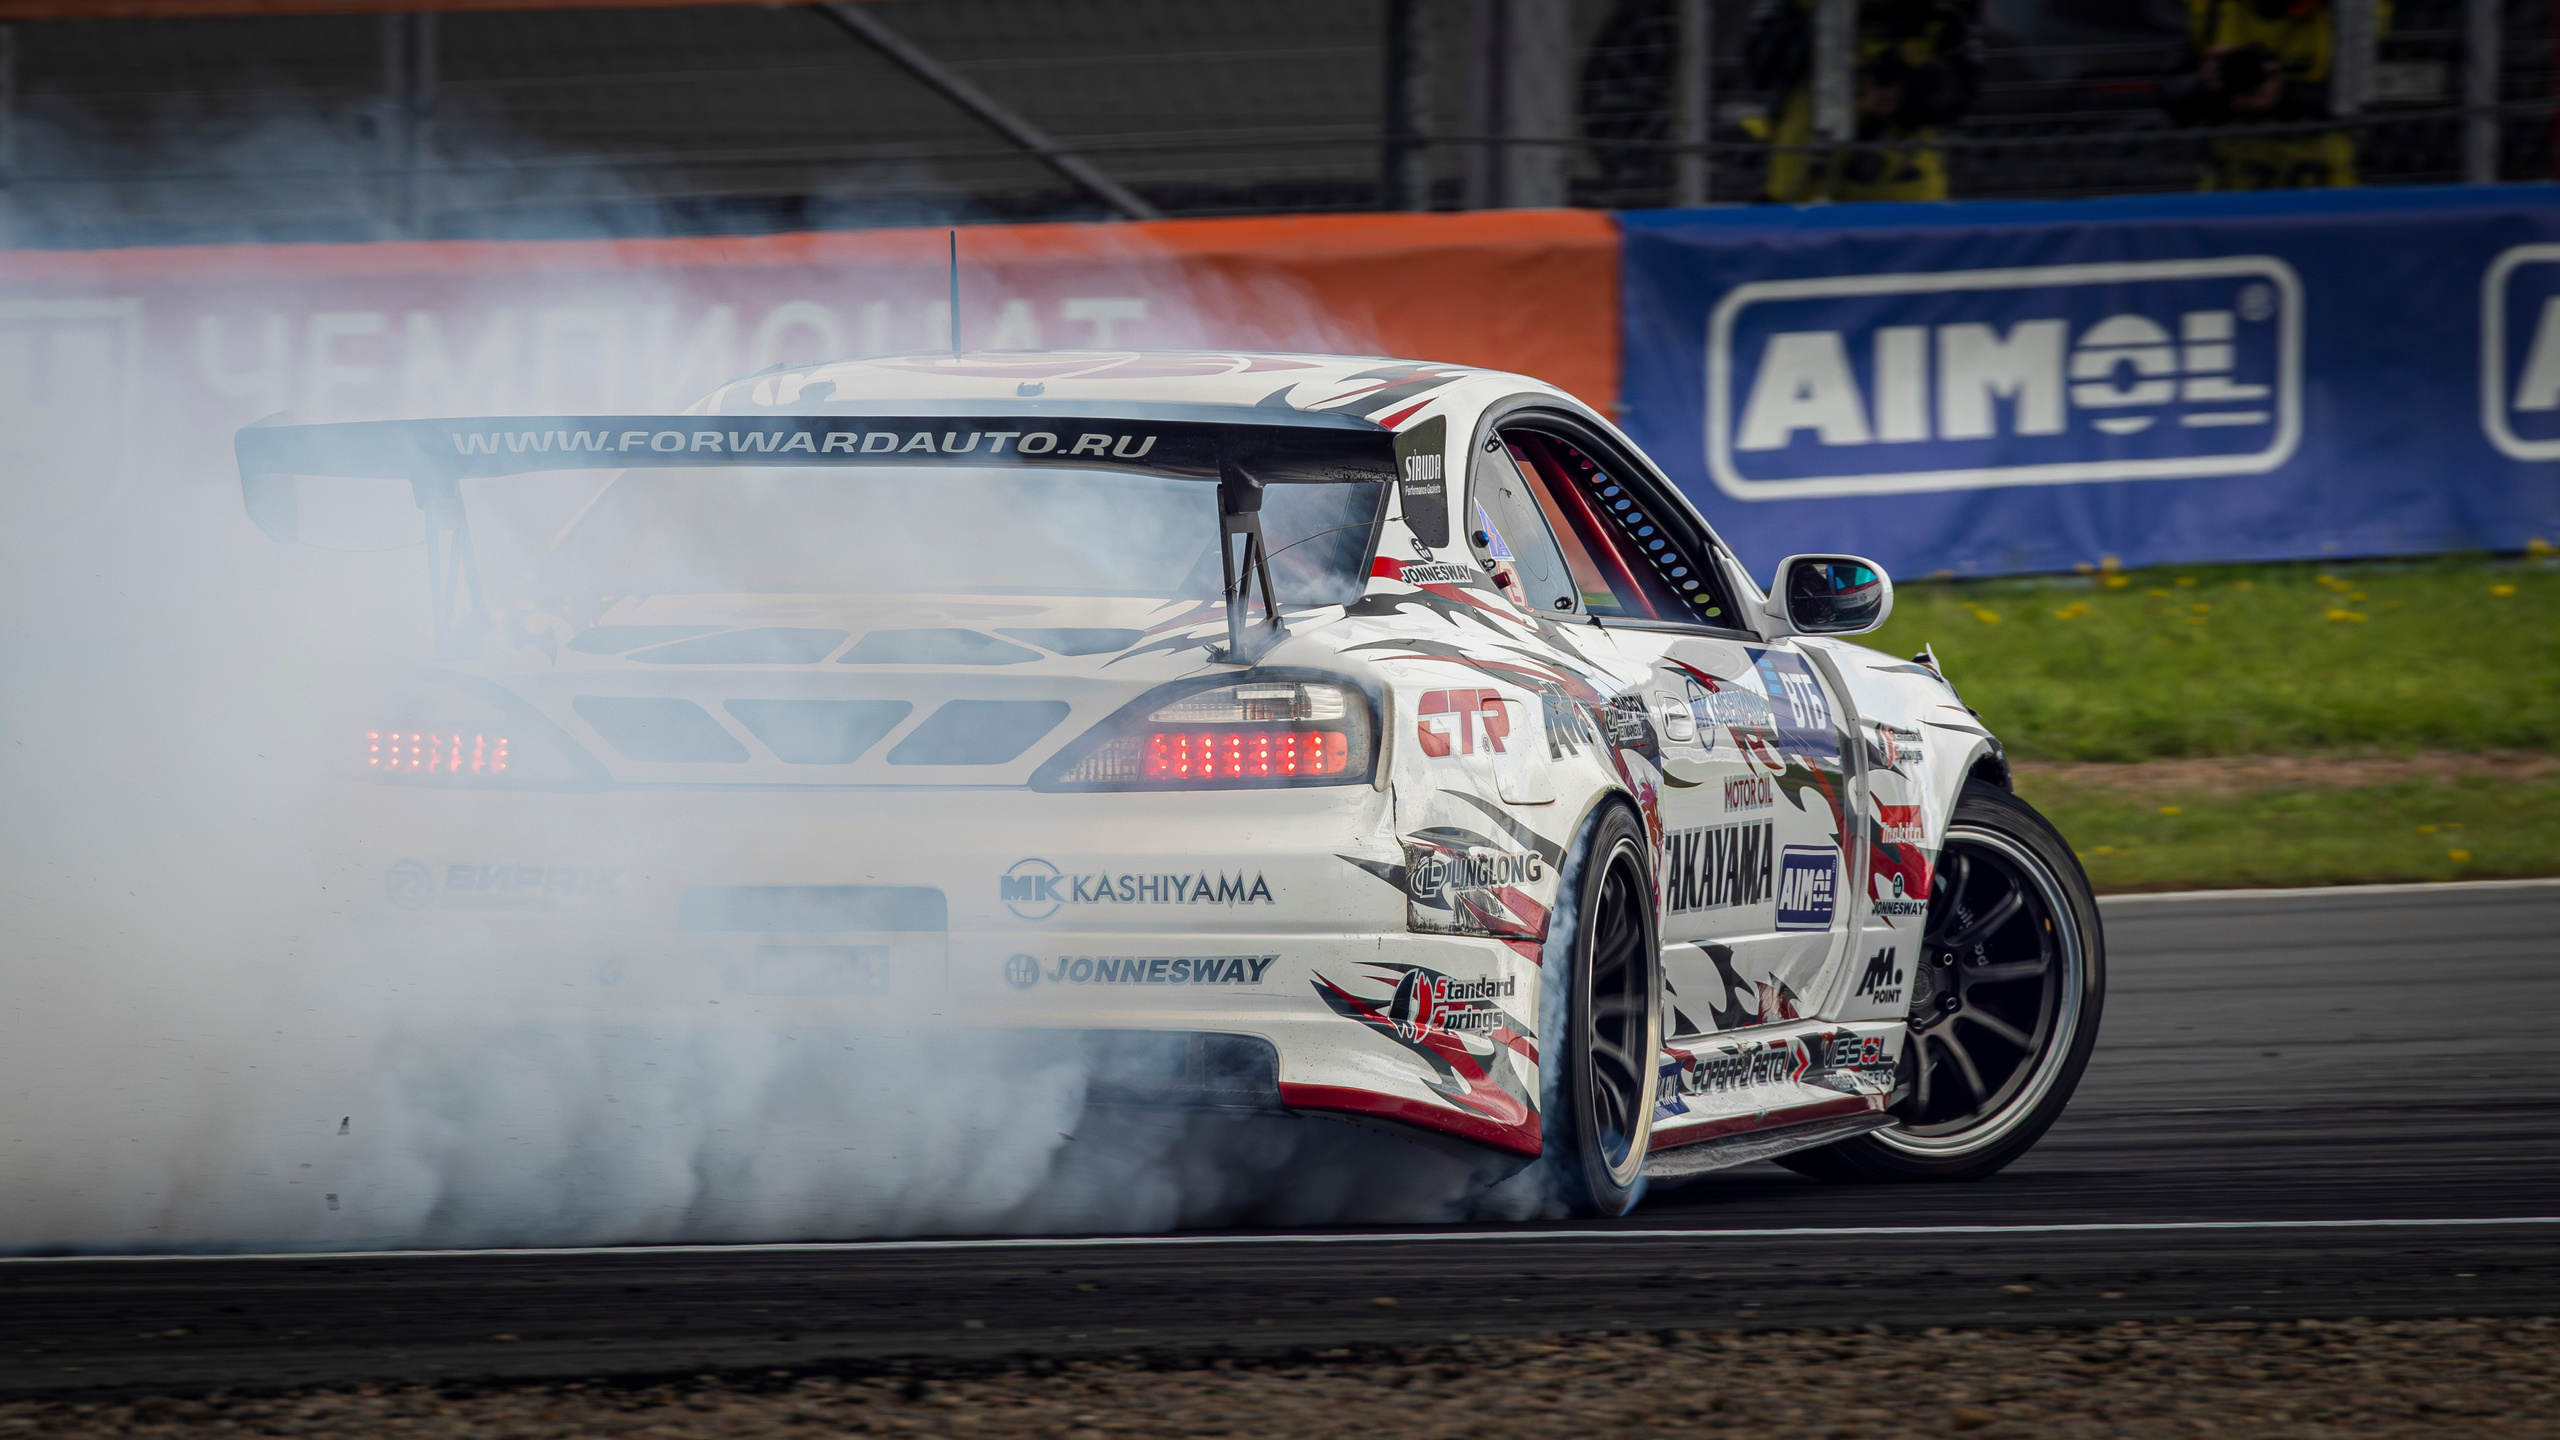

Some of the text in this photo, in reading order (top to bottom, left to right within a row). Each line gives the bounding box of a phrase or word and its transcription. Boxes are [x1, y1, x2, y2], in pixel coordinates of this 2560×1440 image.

[1735, 311, 2271, 451] AIMOL
[452, 429, 1158, 459] WWW.FORWARDAUTO.RU
[1403, 564, 1472, 584] JONNESWAY
[1779, 672, 1827, 730] ВТБ
[1724, 774, 1774, 811] MOTOR OIL
[1451, 852, 1543, 889] LINGLONG
[1667, 822, 1774, 913] AKAYAMA
[1072, 870, 1275, 904] KASHIYAMA
[1779, 867, 1833, 912] AIMOL
[1872, 902, 1926, 916] JONNESWAY
[1048, 956, 1276, 985] JONNESWAY
[1434, 974, 1515, 1000] Standard
[1873, 989, 1902, 1004] POINT
[1433, 1006, 1503, 1036] Springs
